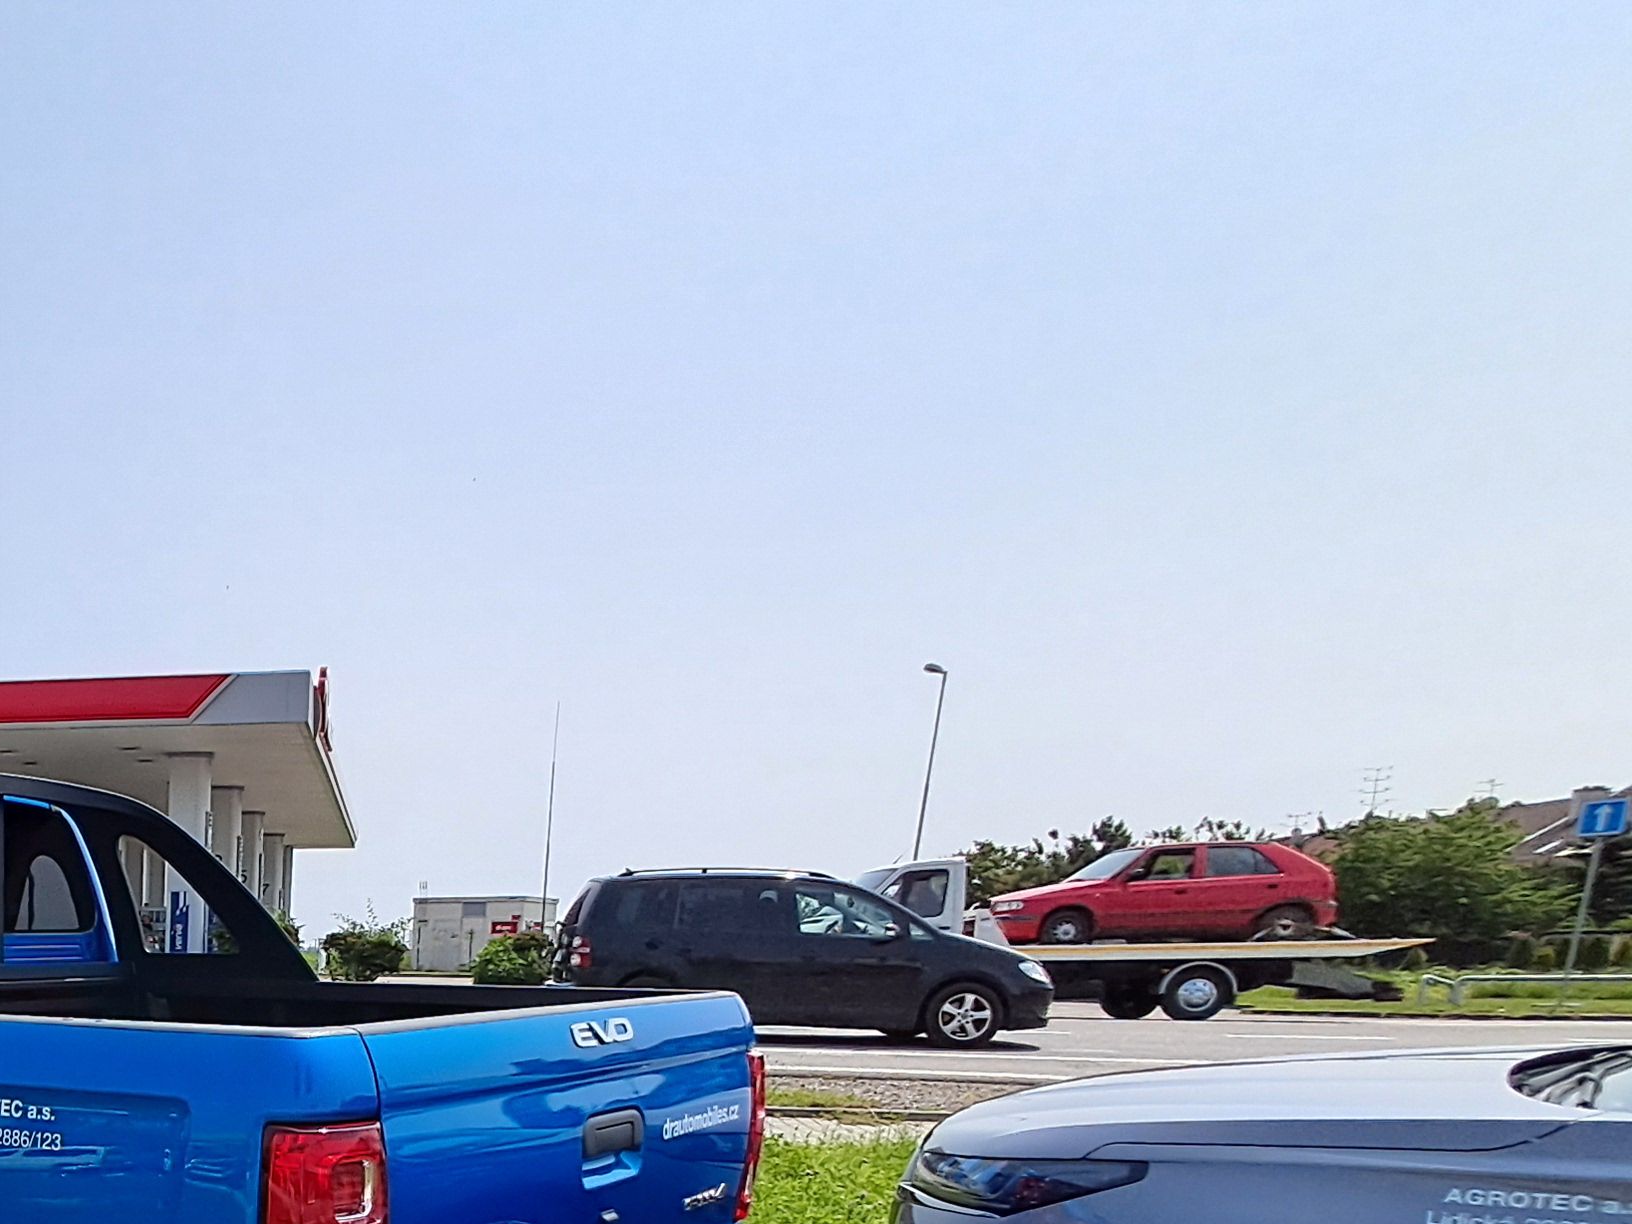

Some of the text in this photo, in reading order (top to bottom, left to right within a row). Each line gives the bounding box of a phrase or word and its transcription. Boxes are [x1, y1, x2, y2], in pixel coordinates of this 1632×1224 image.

[570, 1017, 634, 1048] EVO
[27, 1105, 56, 1121] a.s.
[662, 1104, 740, 1141] drautomobiles.cz
[1443, 1187, 1594, 1212] AGROTEC
